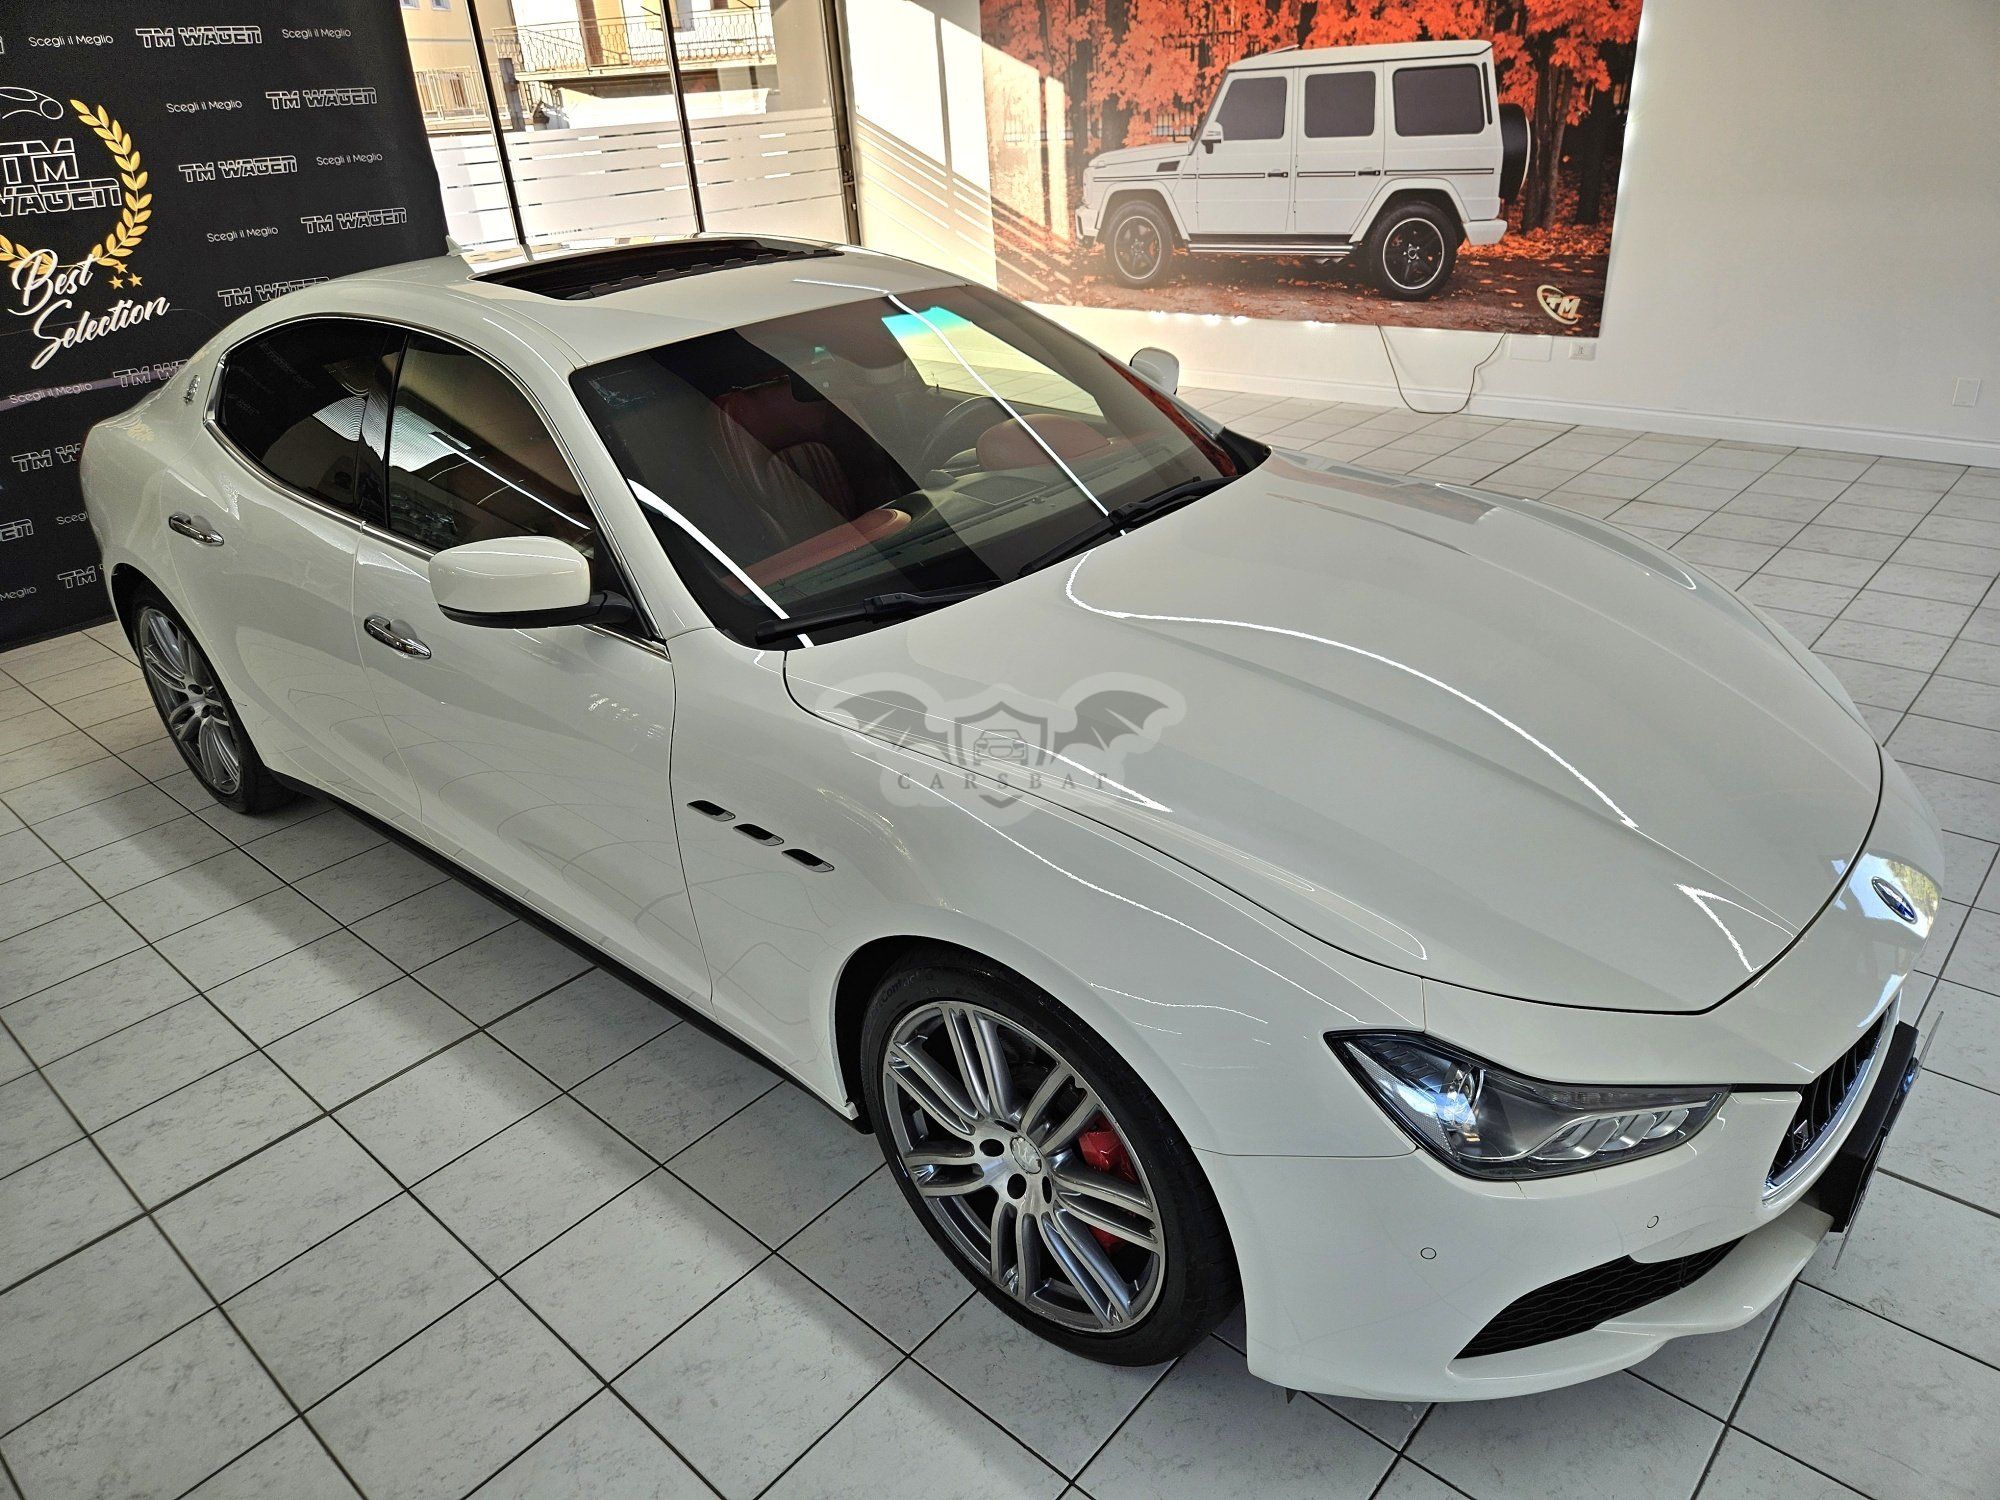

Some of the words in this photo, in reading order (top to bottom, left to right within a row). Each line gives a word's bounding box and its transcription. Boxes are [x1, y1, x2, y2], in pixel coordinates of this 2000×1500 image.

[28, 36, 65, 47] Scegli
[67, 36, 73, 44] il
[75, 34, 113, 46] Meglio
[135, 28, 175, 48] TM
[282, 28, 312, 39] Scegli
[321, 27, 351, 38] Meglio
[167, 102, 199, 114] Scegli
[209, 100, 242, 110] Meglio
[265, 91, 301, 110] TM
[316, 155, 345, 166] Scegli
[353, 153, 383, 163] Meglio
[178, 162, 215, 182] TM
[300, 214, 334, 234] TM
[207, 231, 238, 243] Scegli
[246, 226, 278, 238] Meglio
[8, 249, 95, 315] Best
[217, 287, 253, 307] TM
[31, 296, 170, 370] Selection
[113, 366, 151, 388] TM
[10, 391, 46, 404] Scegli
[56, 383, 93, 395] Meglio
[12, 449, 53, 472] TM
[57, 565, 97, 589] TM
